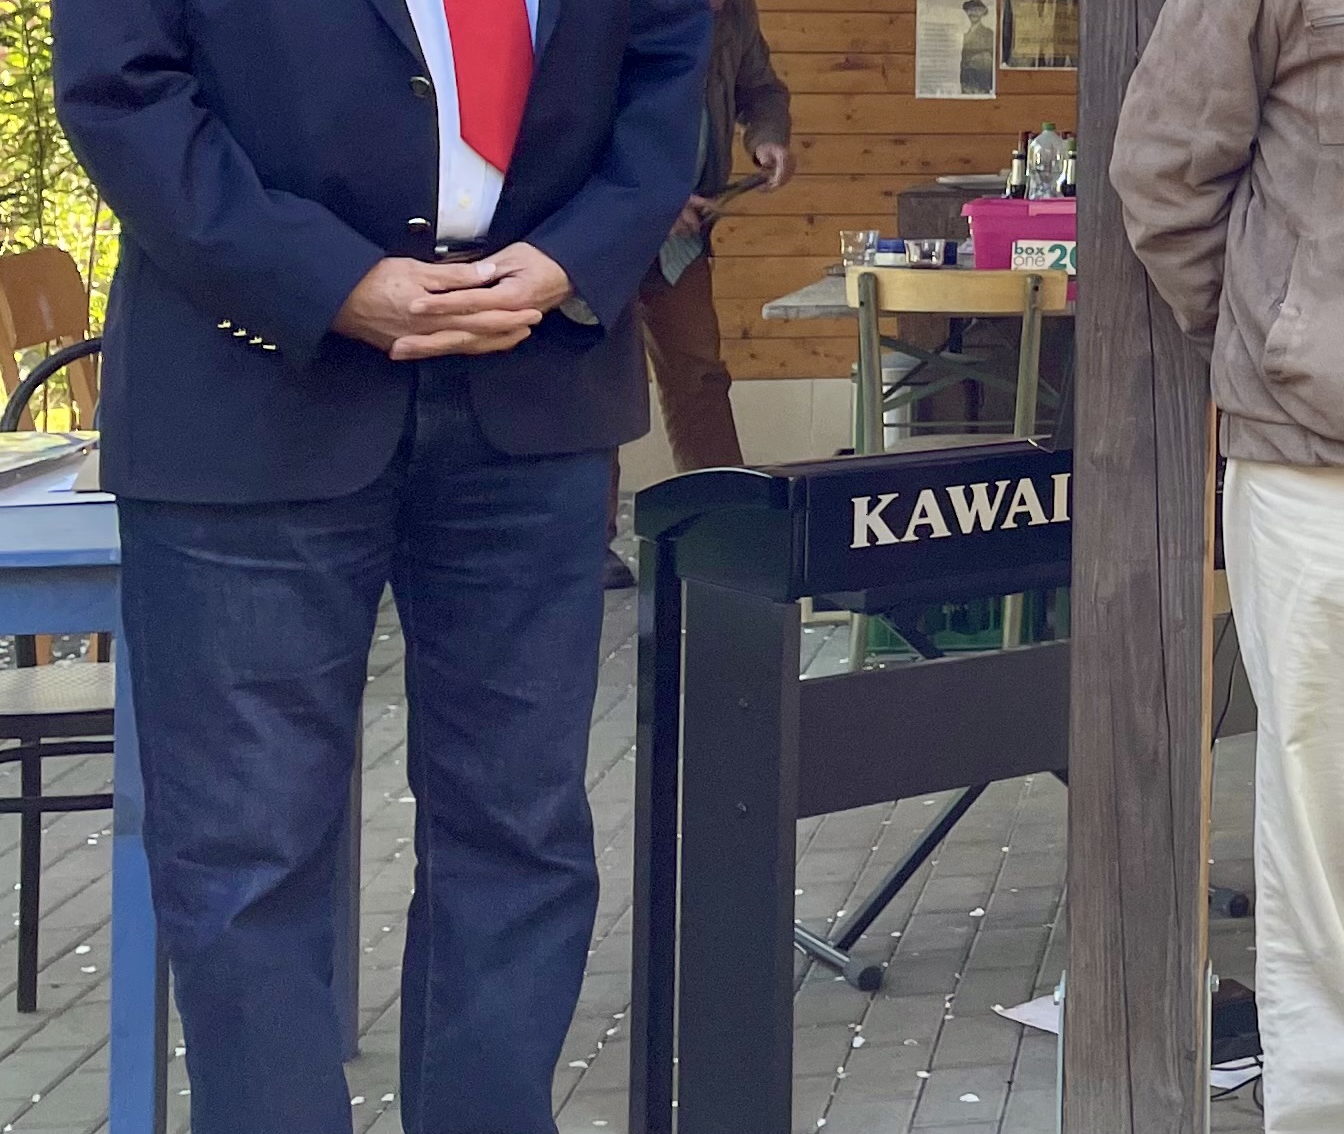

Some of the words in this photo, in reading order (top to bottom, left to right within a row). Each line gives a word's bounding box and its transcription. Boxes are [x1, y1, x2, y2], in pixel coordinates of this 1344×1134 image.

[1014, 241, 1045, 256] box
[1014, 256, 1045, 267] one
[850, 473, 1071, 548] KAWAI
